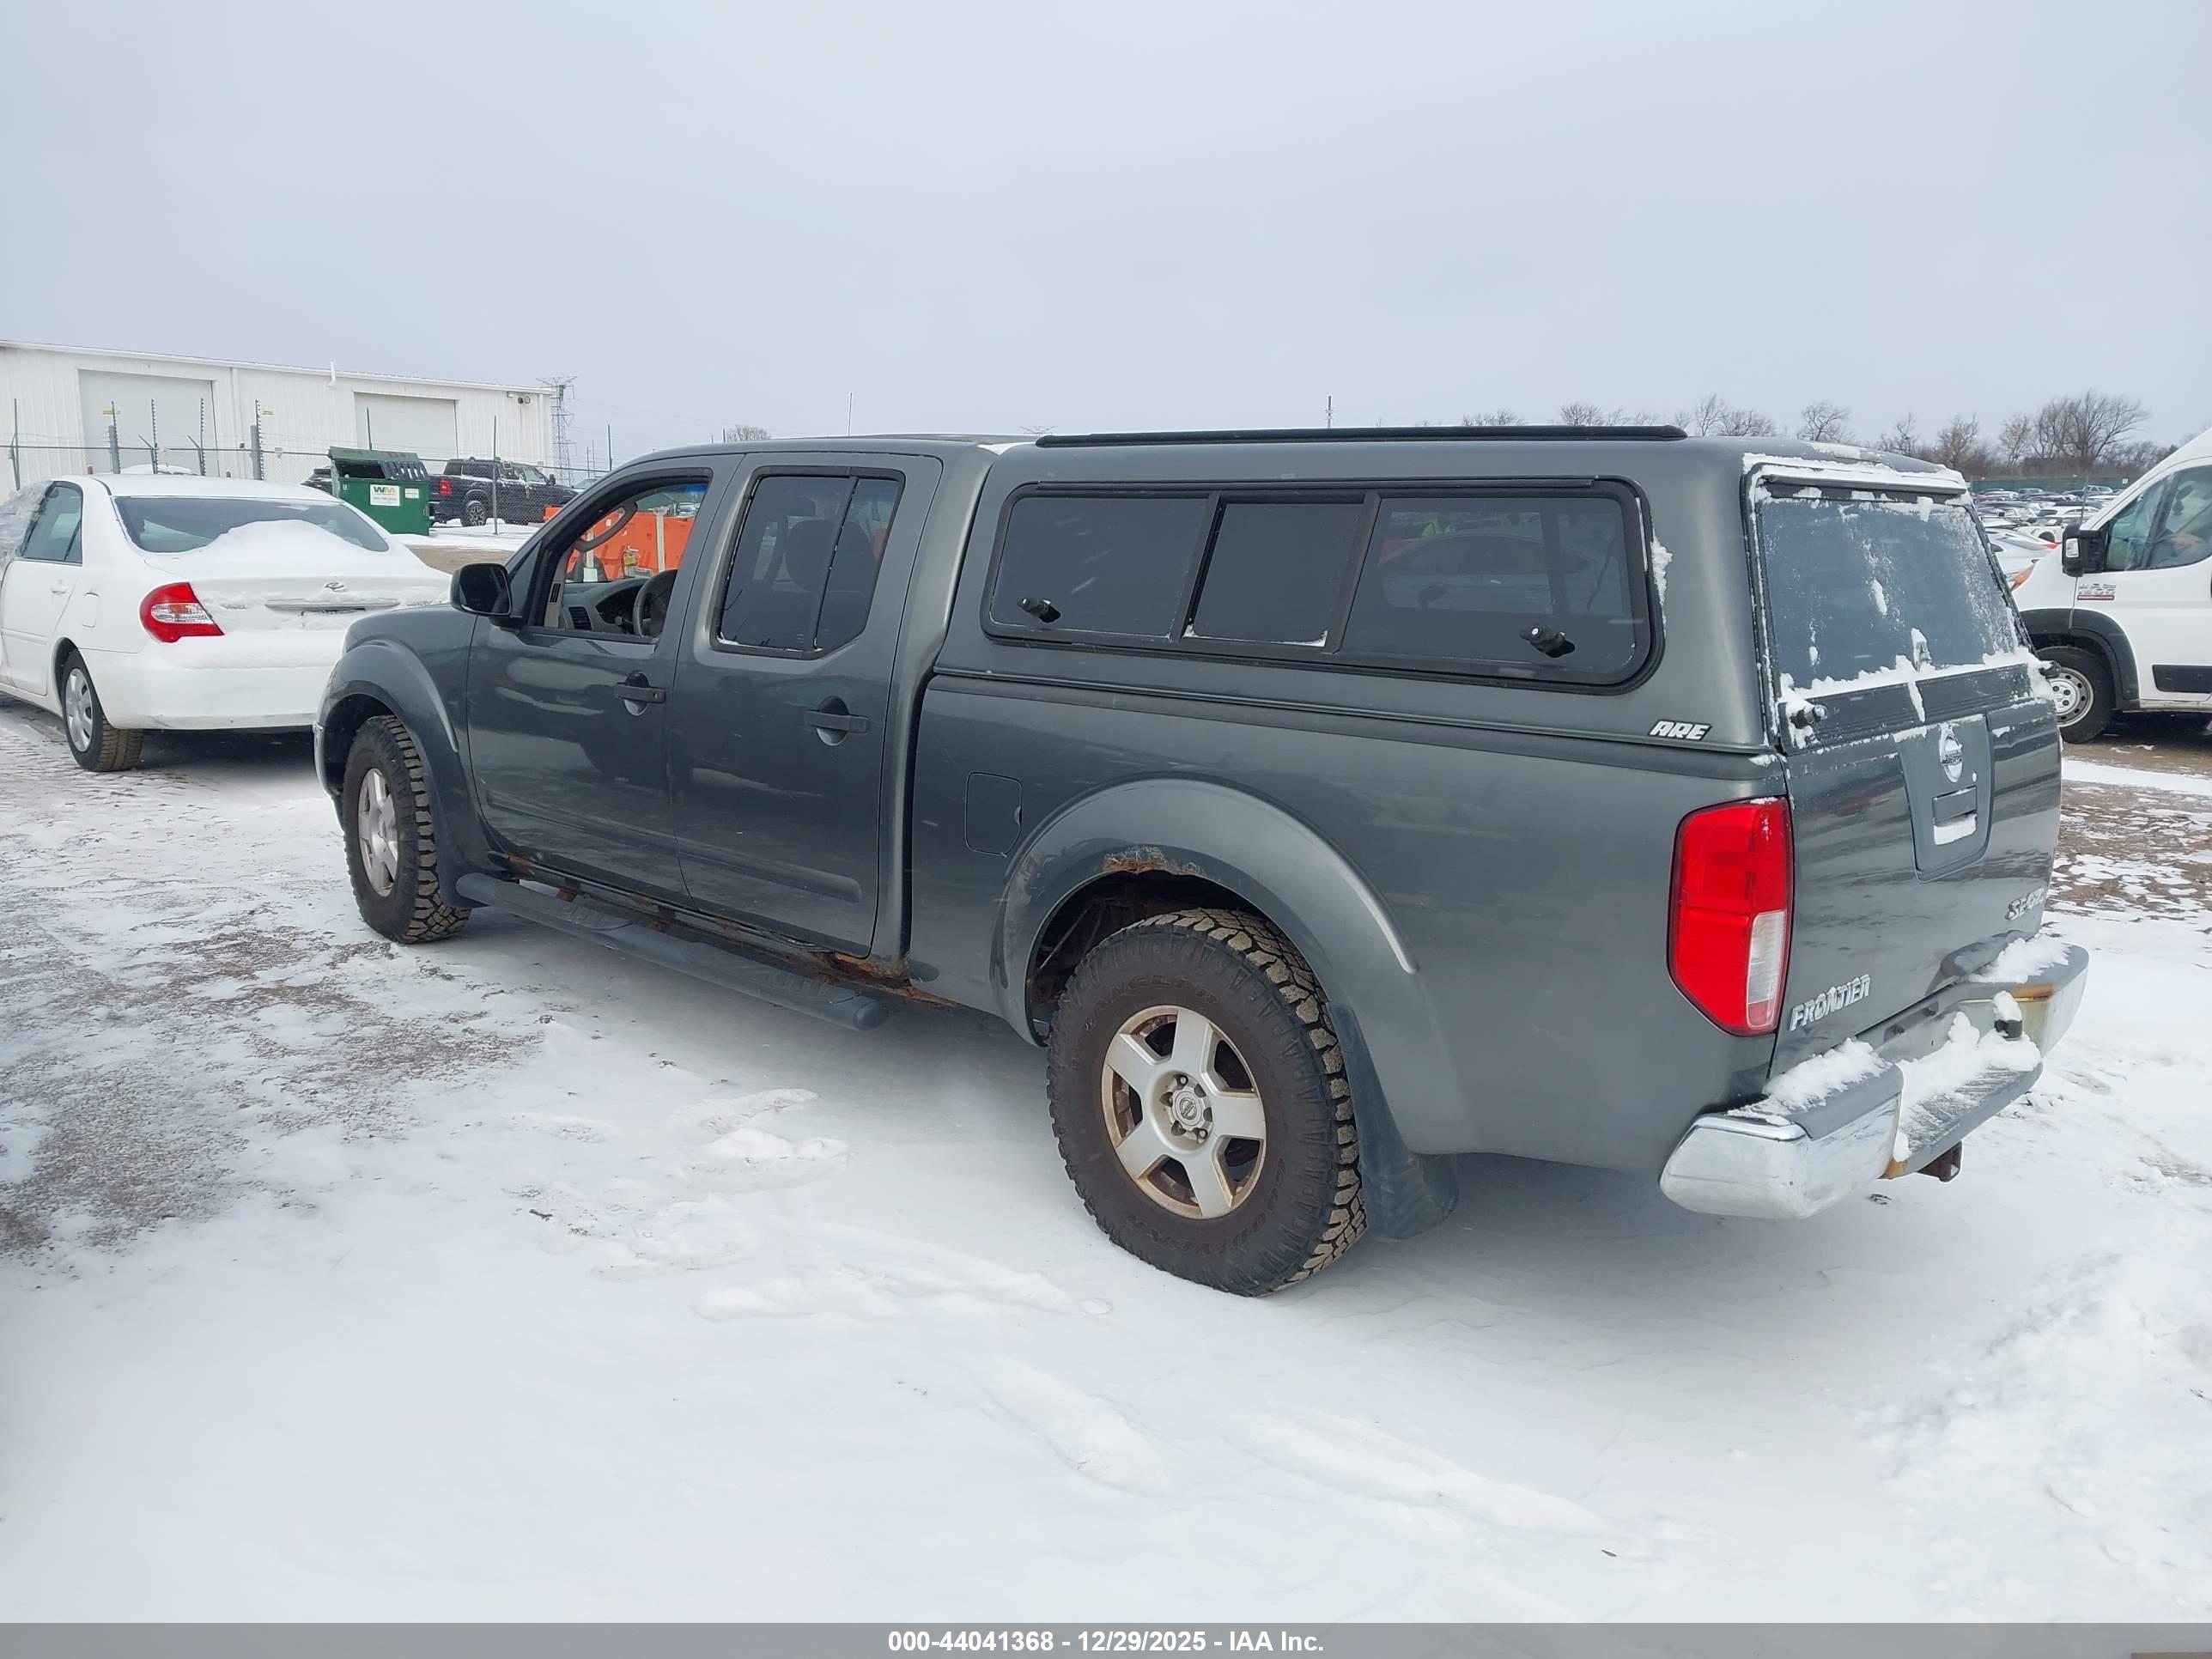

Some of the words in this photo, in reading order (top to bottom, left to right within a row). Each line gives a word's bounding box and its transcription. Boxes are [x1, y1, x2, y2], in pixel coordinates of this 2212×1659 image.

[373, 485, 396, 494] WM
[1649, 720, 1711, 740] ARE
[1789, 974, 1870, 1031] FRONTIER
